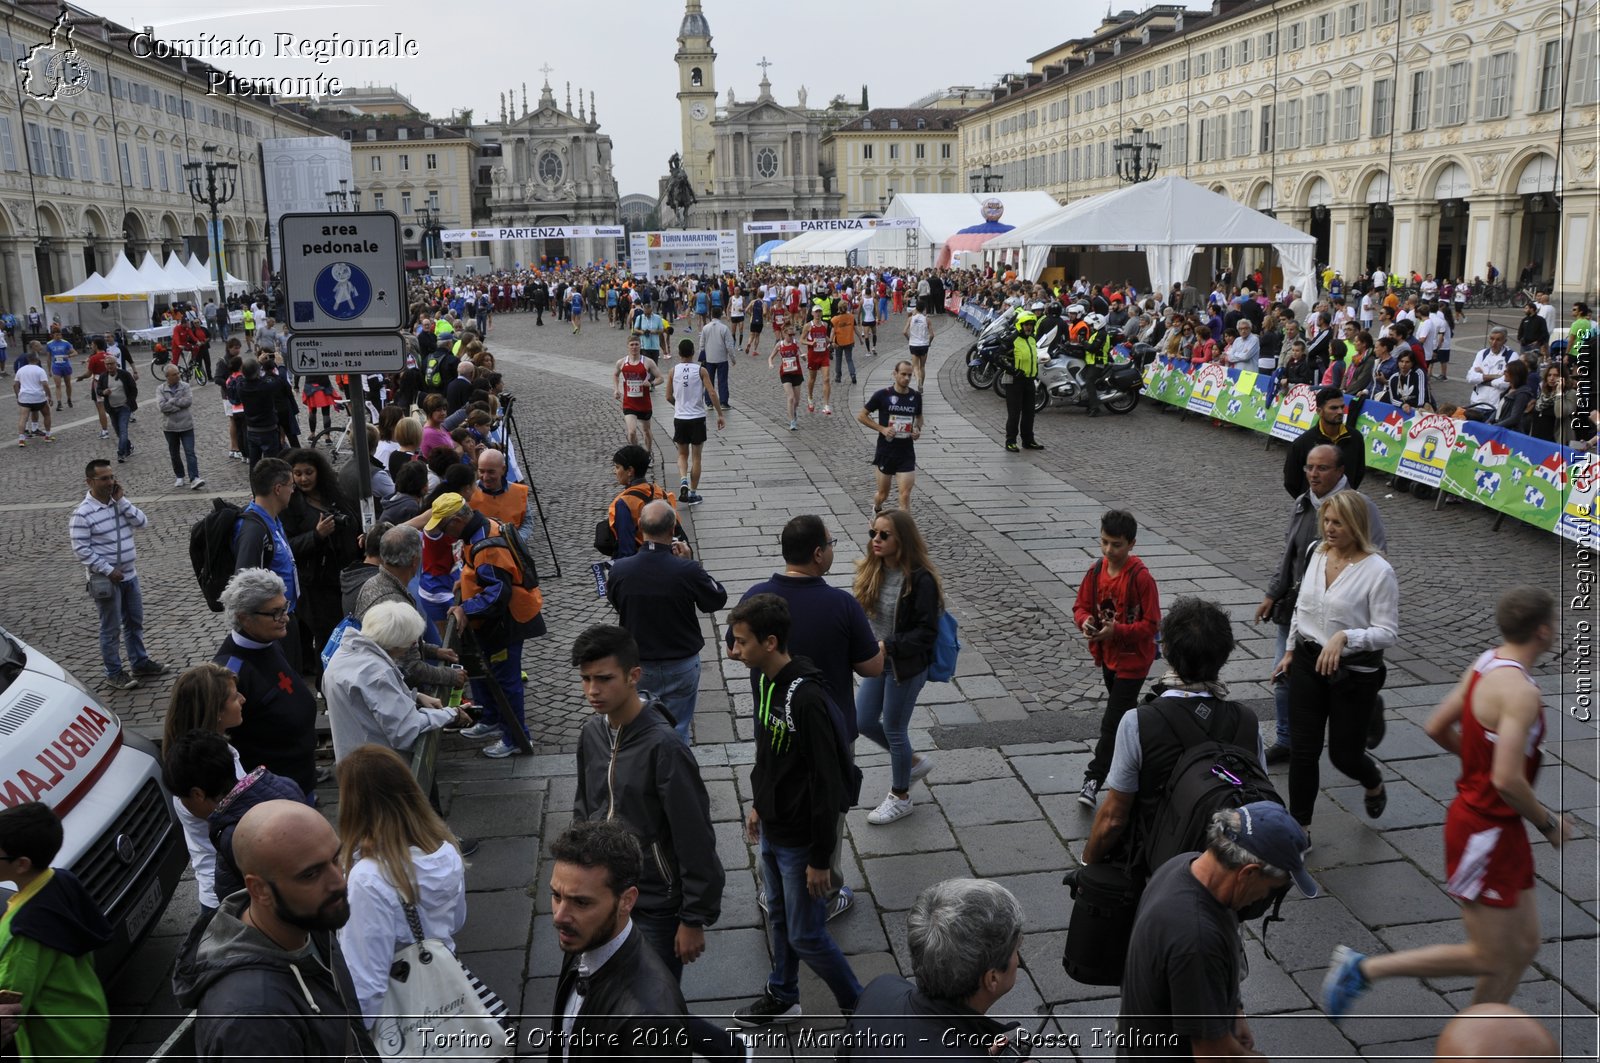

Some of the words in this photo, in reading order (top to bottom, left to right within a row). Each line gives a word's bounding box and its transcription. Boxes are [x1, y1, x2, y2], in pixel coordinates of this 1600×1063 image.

[322, 224, 358, 236] area
[800, 220, 864, 231] PARTENZA
[500, 227, 565, 239] PARTENZA
[662, 234, 681, 242] TURIN
[682, 233, 718, 242] MARATHON
[302, 240, 379, 256] pedonale
[364, 348, 398, 356] autorizzati
[890, 405, 915, 413] FRANCE
[1410, 414, 1455, 447] TAPPOROSSO
[592, 564, 606, 597] TORINO
